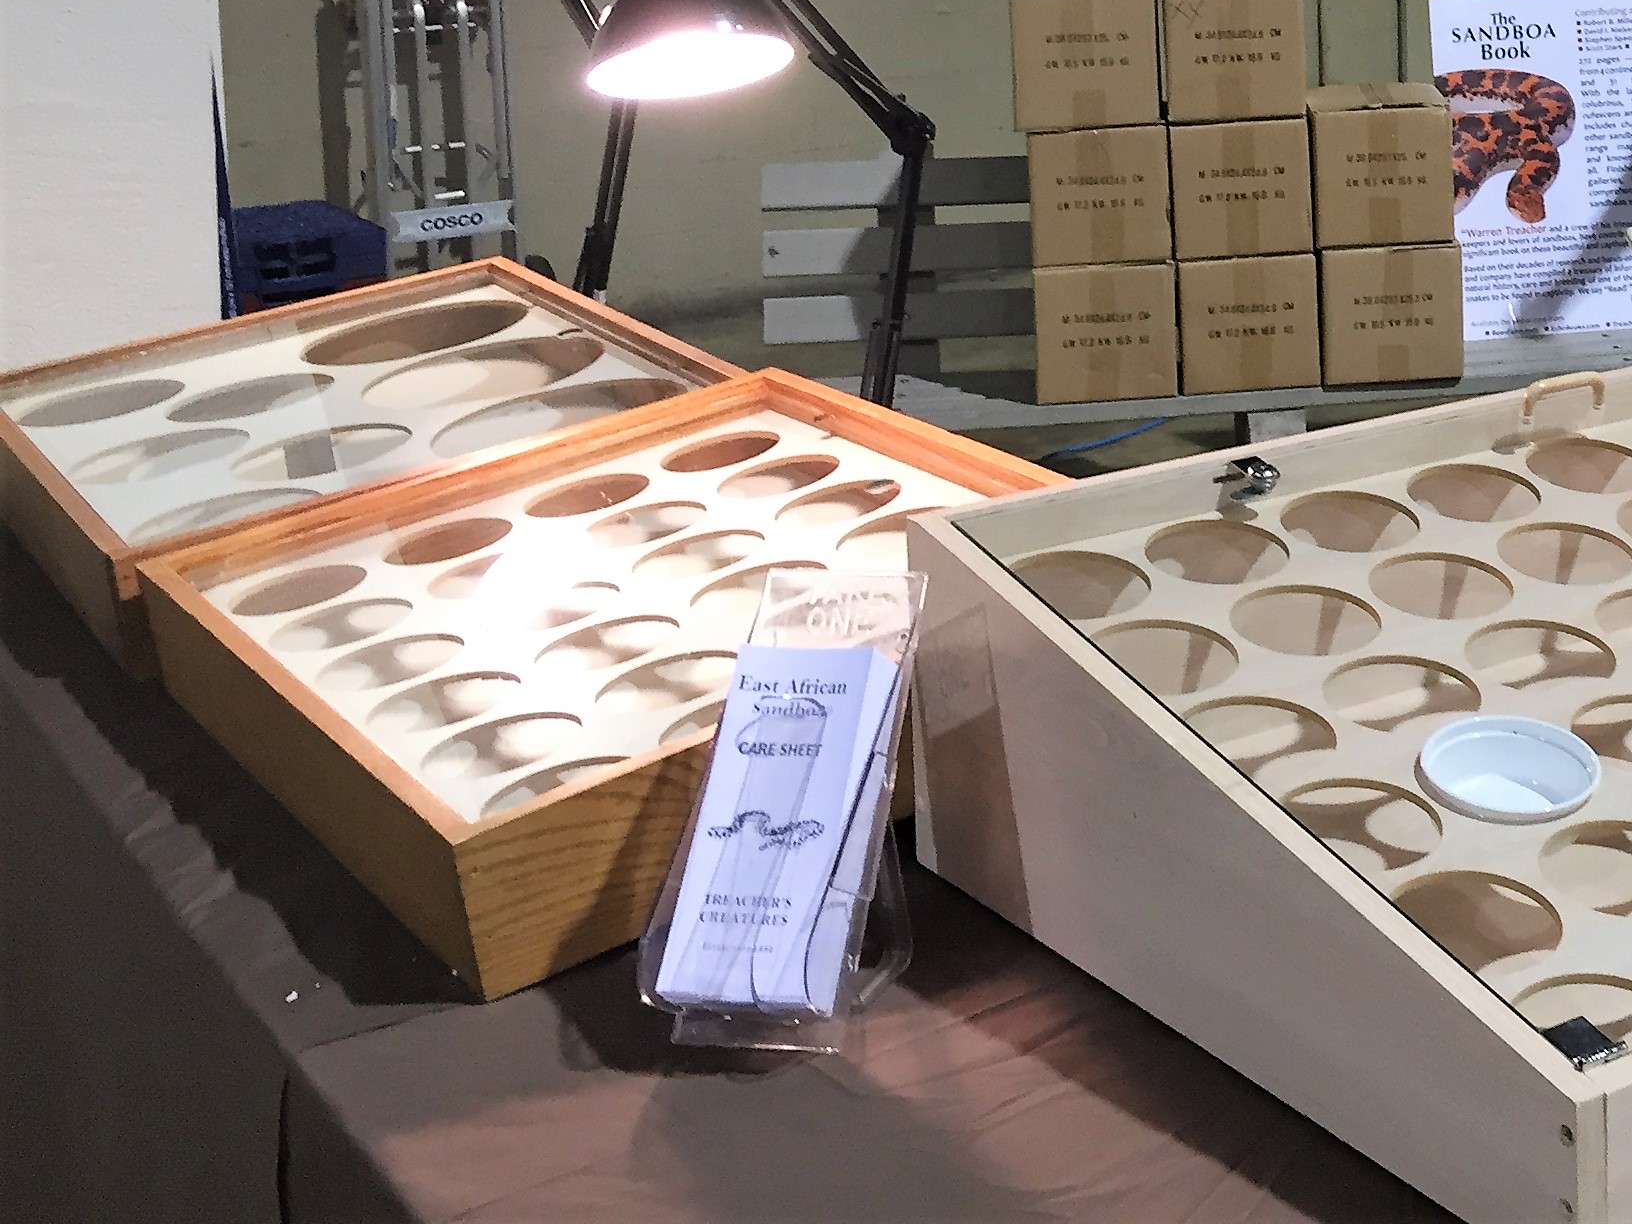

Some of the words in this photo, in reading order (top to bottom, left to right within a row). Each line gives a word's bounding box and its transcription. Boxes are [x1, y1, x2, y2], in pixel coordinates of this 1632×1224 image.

[1490, 11, 1516, 26] The
[1451, 23, 1557, 44] SANDBOA
[1481, 40, 1532, 61] Book
[420, 212, 483, 232] COSCO
[738, 674, 779, 693] East
[789, 678, 847, 695] African
[737, 742, 776, 756] CARE
[778, 743, 823, 758] SHEET
